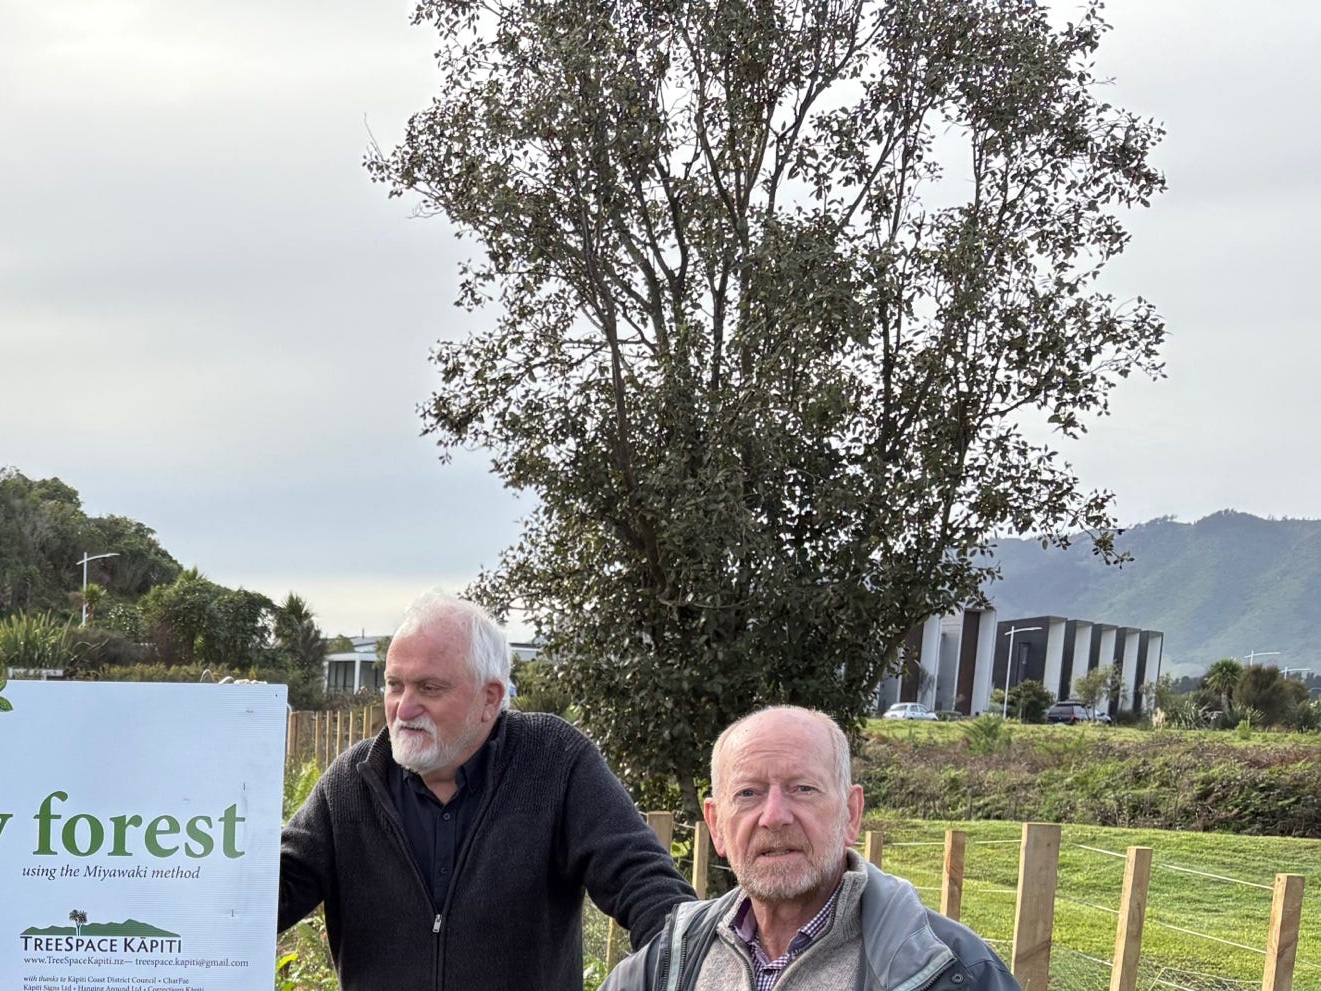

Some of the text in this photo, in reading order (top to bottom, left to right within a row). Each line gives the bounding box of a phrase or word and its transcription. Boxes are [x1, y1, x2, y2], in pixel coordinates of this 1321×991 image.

[32, 790, 246, 859] forest
[22, 864, 201, 882] using the Miyawaki method
[19, 936, 118, 953] TREESPACE
[135, 957, 249, 970] treespace.kapiti@gmail.com
[38, 975, 59, 983] thanks
[106, 976, 130, 984] District
[131, 976, 157, 984] Council
[61, 984, 72, 991] Ltd
